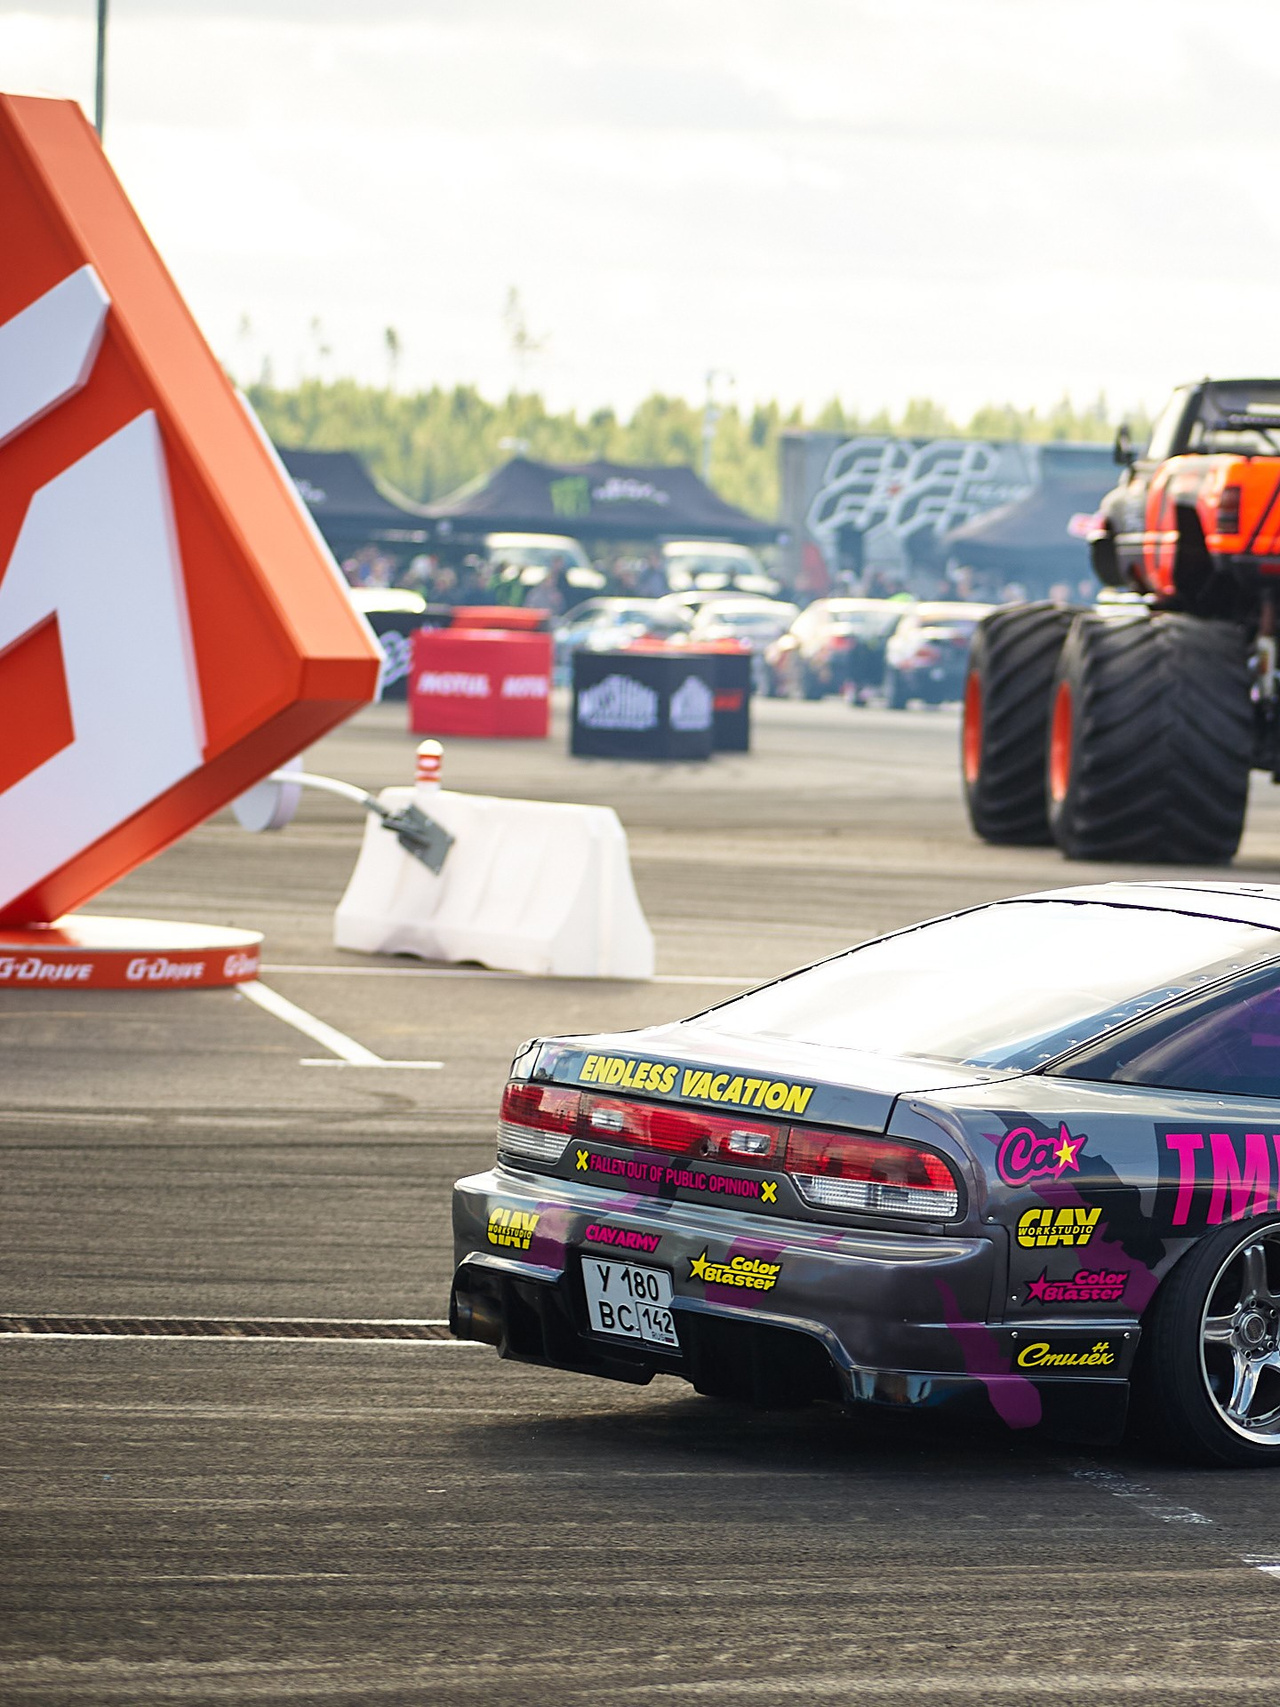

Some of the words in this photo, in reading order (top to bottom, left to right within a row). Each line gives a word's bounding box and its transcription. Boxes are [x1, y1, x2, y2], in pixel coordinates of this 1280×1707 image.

[579, 1055, 678, 1093] ENDLESS
[680, 1069, 814, 1114] VACATION
[590, 1154, 626, 1177] FALLEN
[627, 1160, 648, 1180] OUT
[649, 1165, 664, 1182] OF
[665, 1168, 707, 1190] PUBLIC
[708, 1175, 760, 1199] OPINION
[487, 1224, 533, 1239] WORKSTUDIO
[1018, 1225, 1094, 1236] WORKSTUDIO
[731, 1256, 781, 1275] Color
[620, 1266, 659, 1302] 180
[704, 1267, 776, 1291] Blaster
[1075, 1271, 1129, 1285] Color
[1043, 1286, 1124, 1301] Blaster
[642, 1308, 674, 1335] 142
